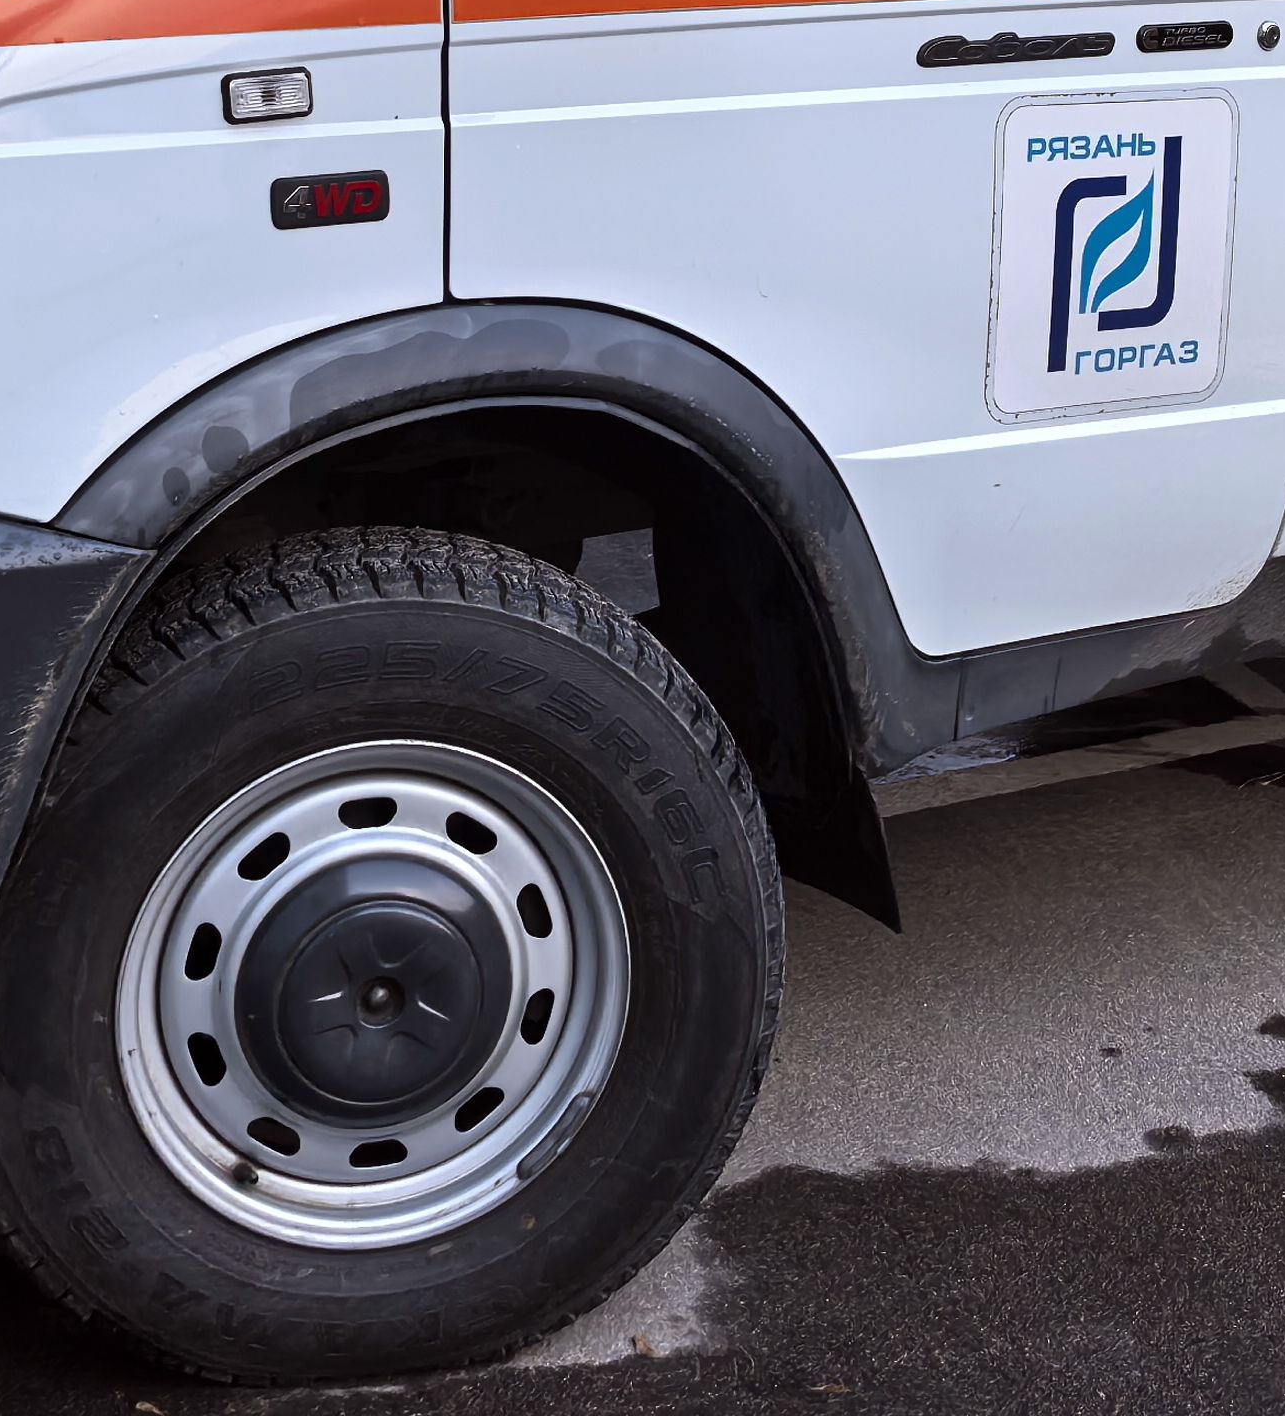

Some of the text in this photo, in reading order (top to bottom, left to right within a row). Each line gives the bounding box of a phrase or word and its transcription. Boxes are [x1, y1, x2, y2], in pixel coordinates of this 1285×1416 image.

[1161, 34, 1228, 47] DIESEL
[1163, 26, 1206, 36] TURBO
[1026, 132, 1157, 163] РЯЗАНЬ
[282, 179, 383, 220] 4WD
[1074, 339, 1200, 376] ГОРГАЗ
[248, 640, 726, 904] 225/75R16C
